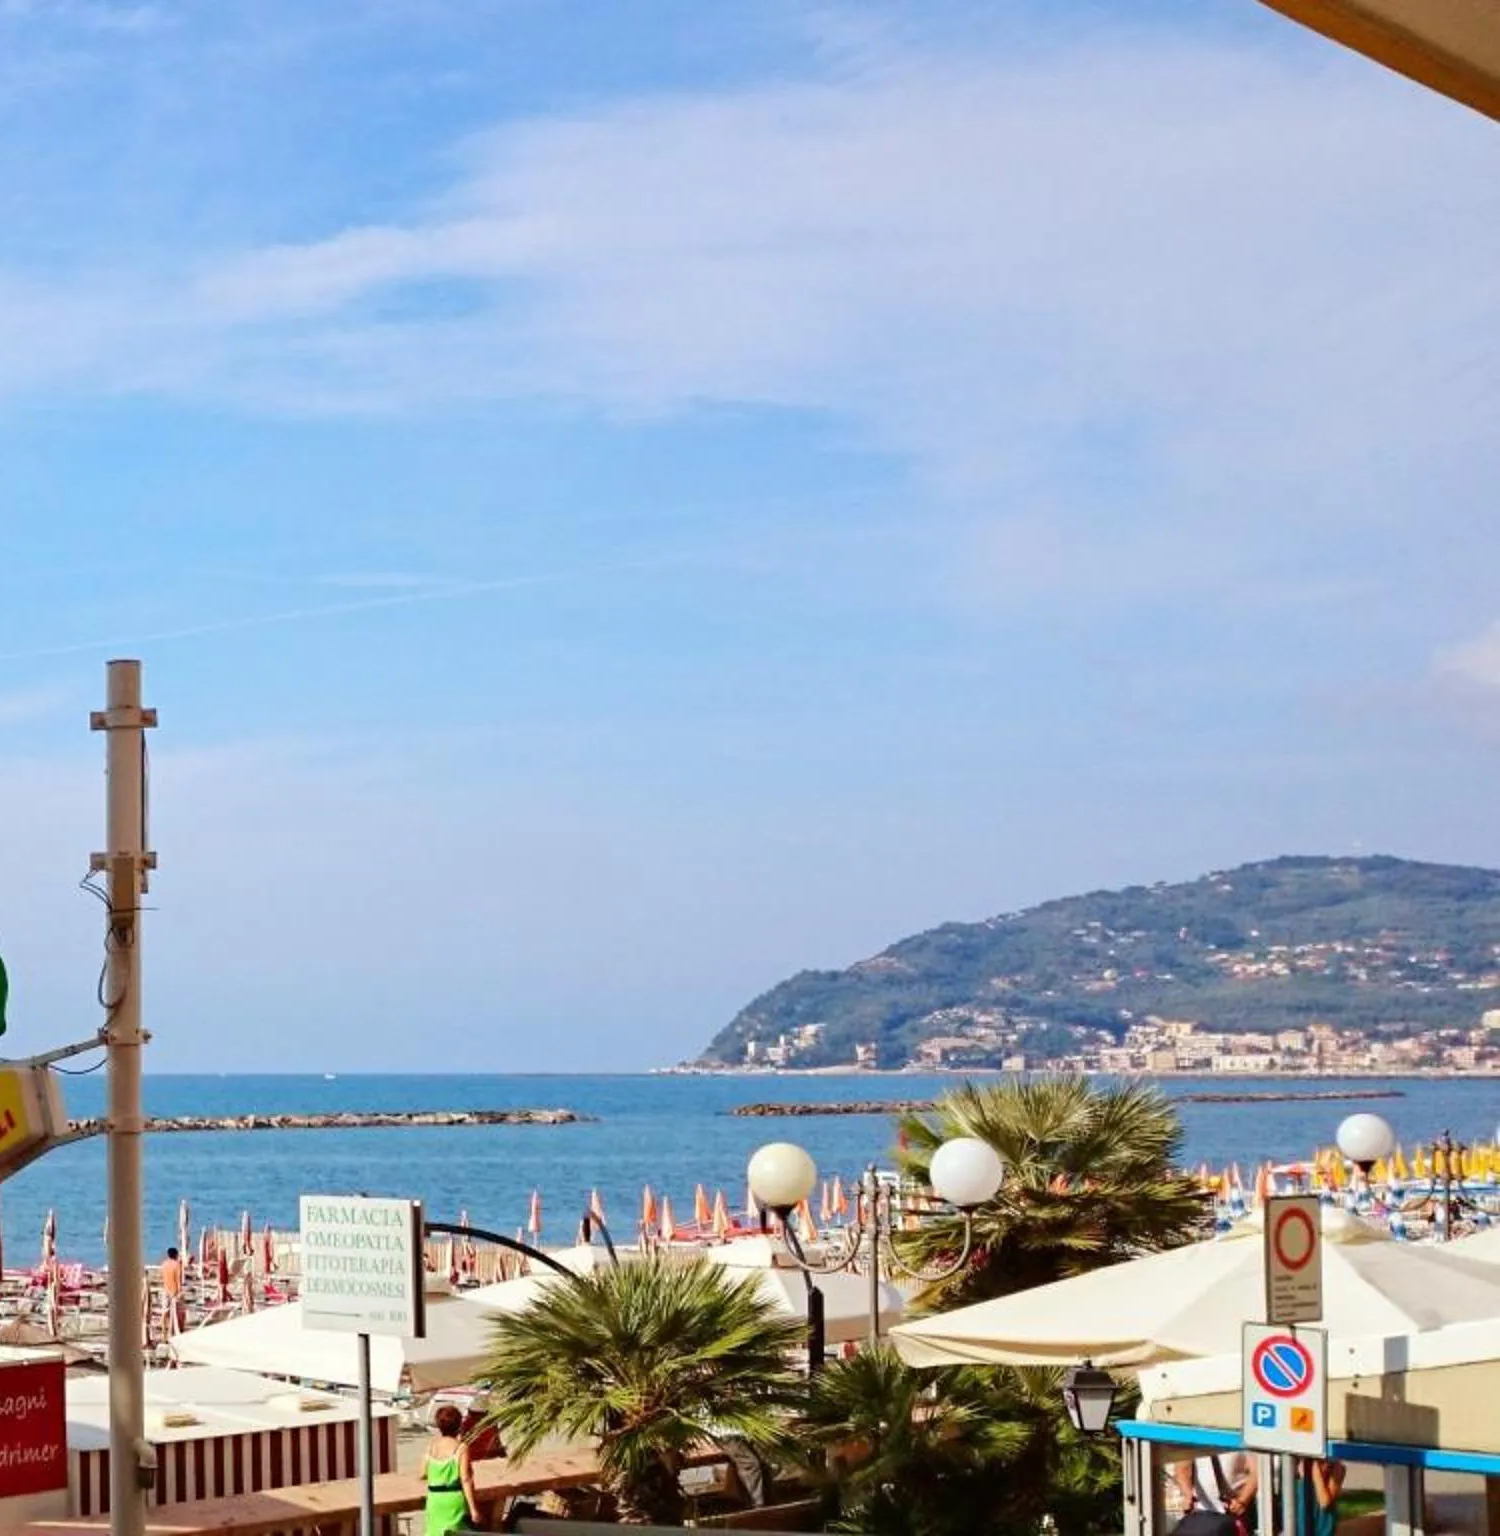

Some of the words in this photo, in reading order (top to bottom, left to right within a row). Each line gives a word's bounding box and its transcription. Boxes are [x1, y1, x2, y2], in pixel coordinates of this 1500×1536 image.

[307, 1205, 403, 1227] FARMACIA
[306, 1230, 404, 1251] OMEOPATIA
[306, 1254, 405, 1275] FITOTERAPIA
[306, 1277, 405, 1299] DERMOCOSMESI
[1257, 1408, 1272, 1423] P
